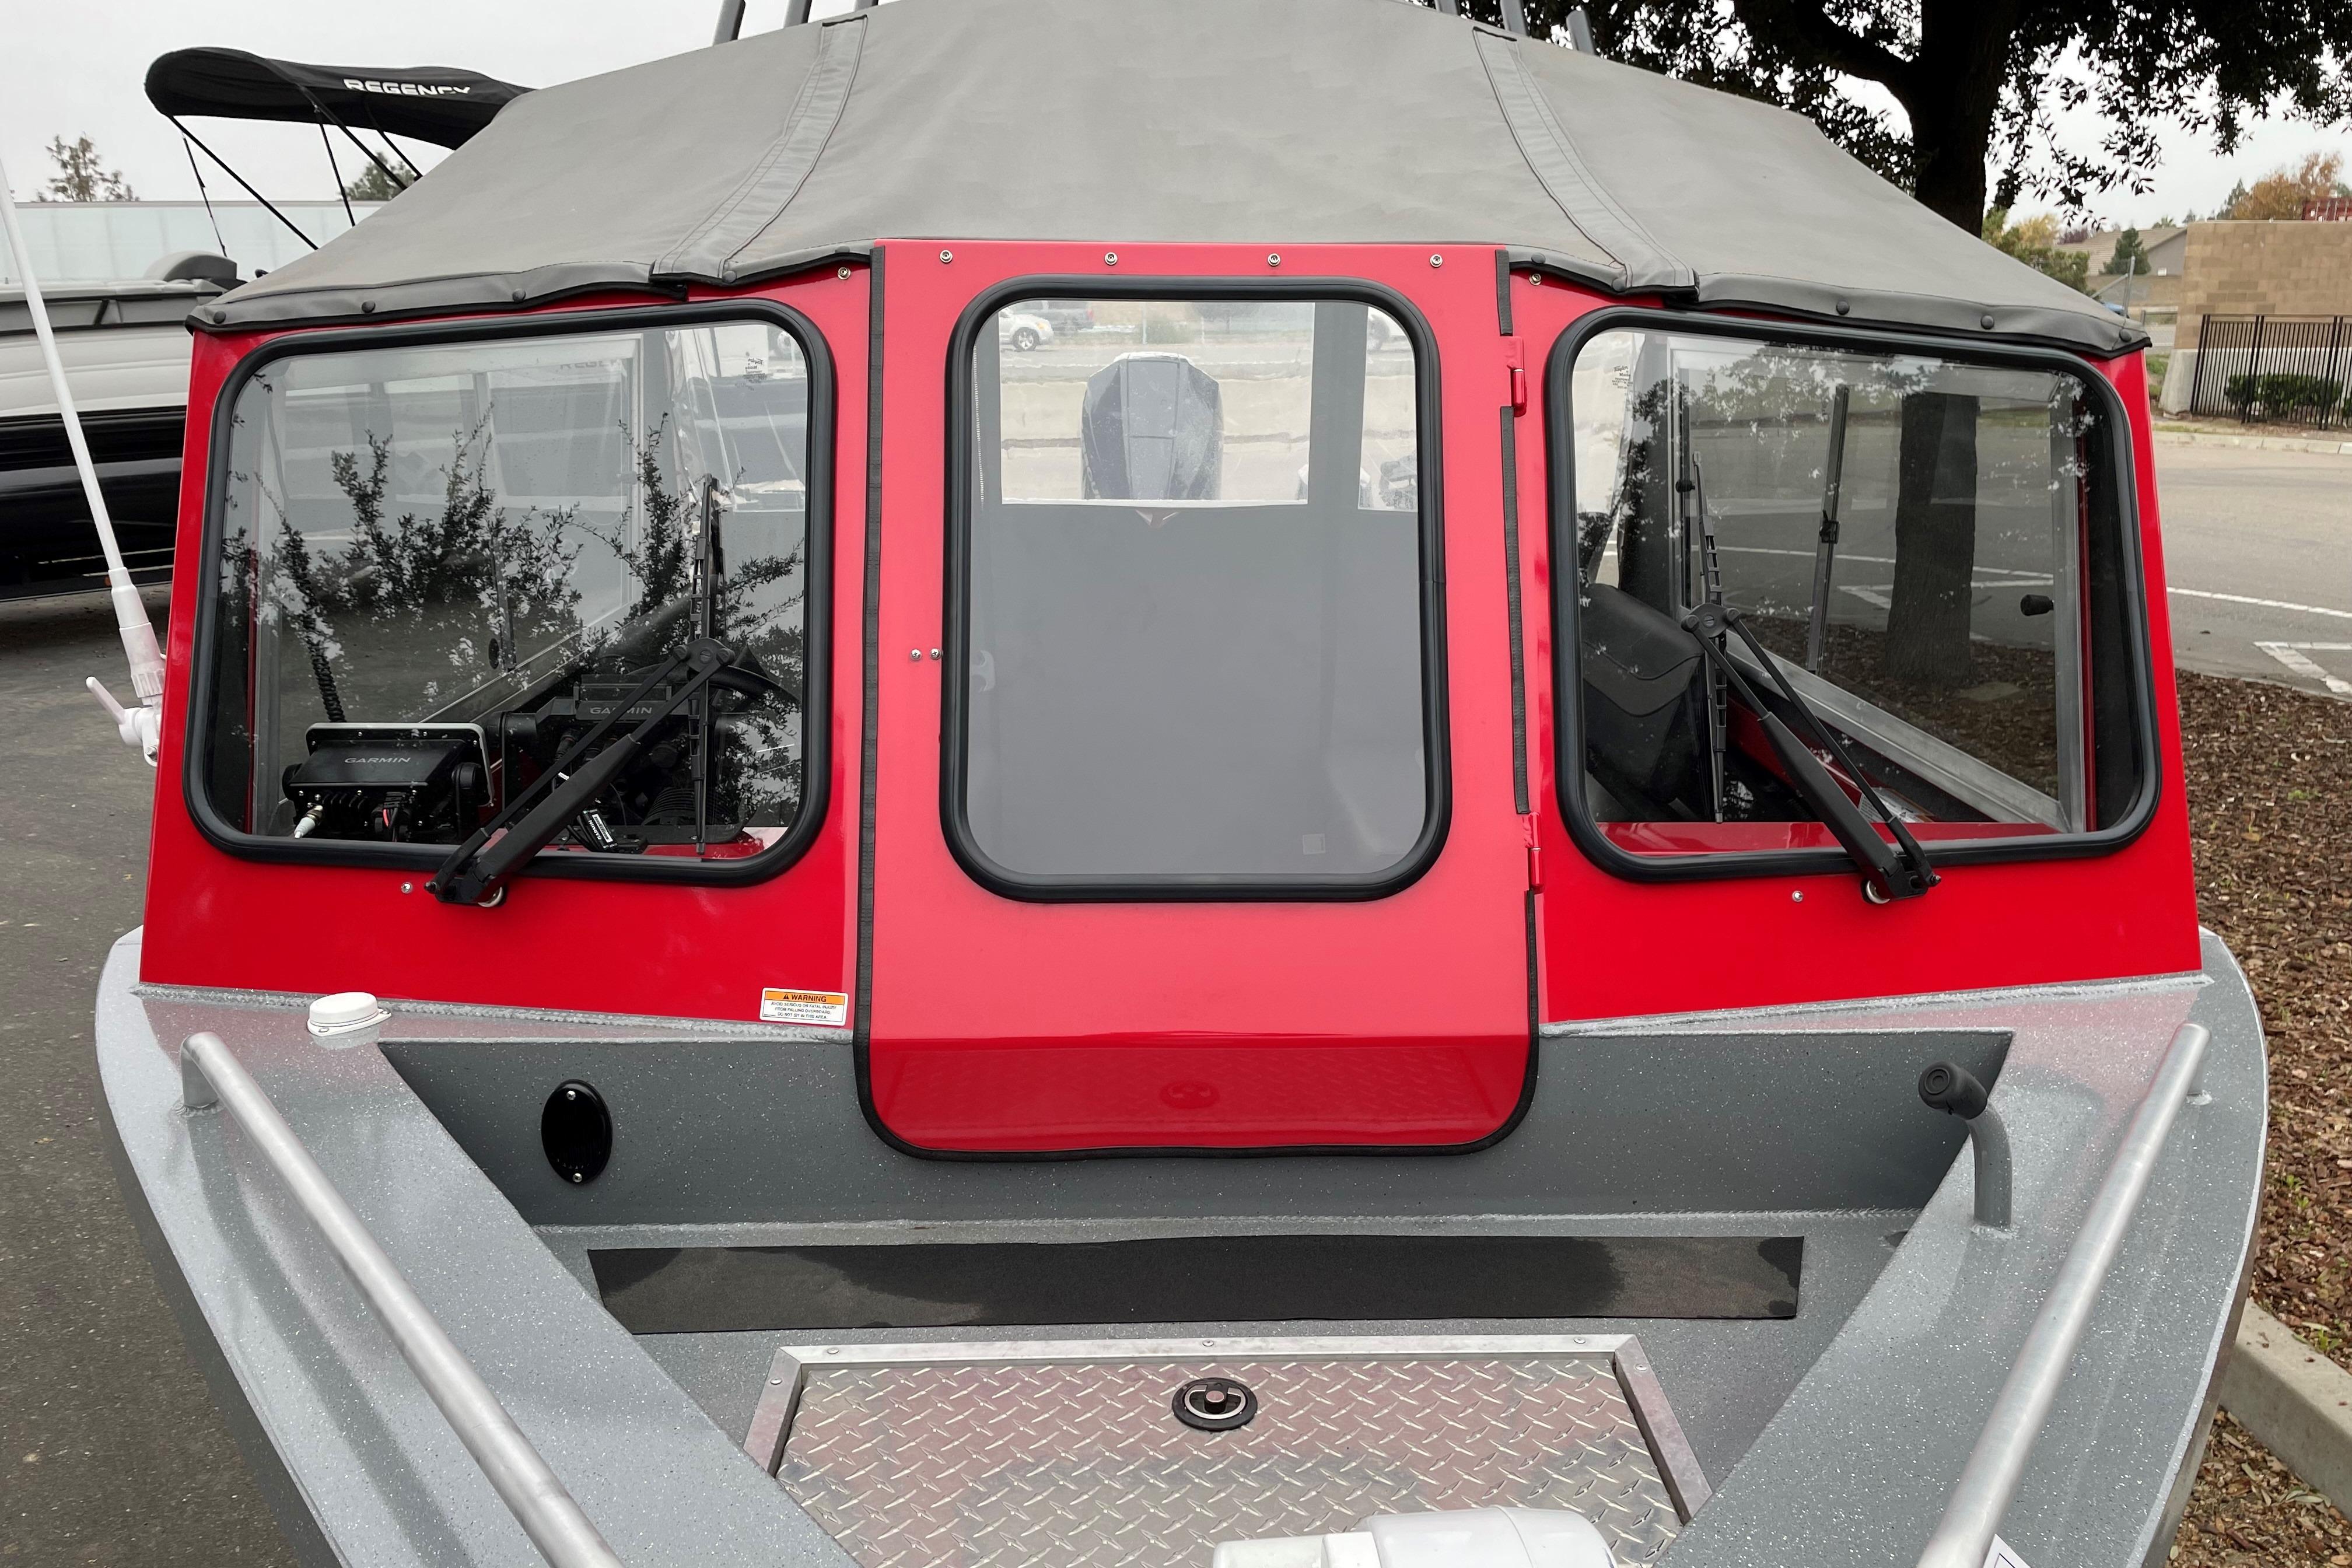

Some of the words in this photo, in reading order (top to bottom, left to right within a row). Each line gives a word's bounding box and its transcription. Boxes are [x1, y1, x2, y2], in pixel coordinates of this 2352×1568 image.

[344, 78, 471, 95] REGENCY
[588, 820, 603, 841] GARMIN
[791, 993, 827, 1002] WARNING
